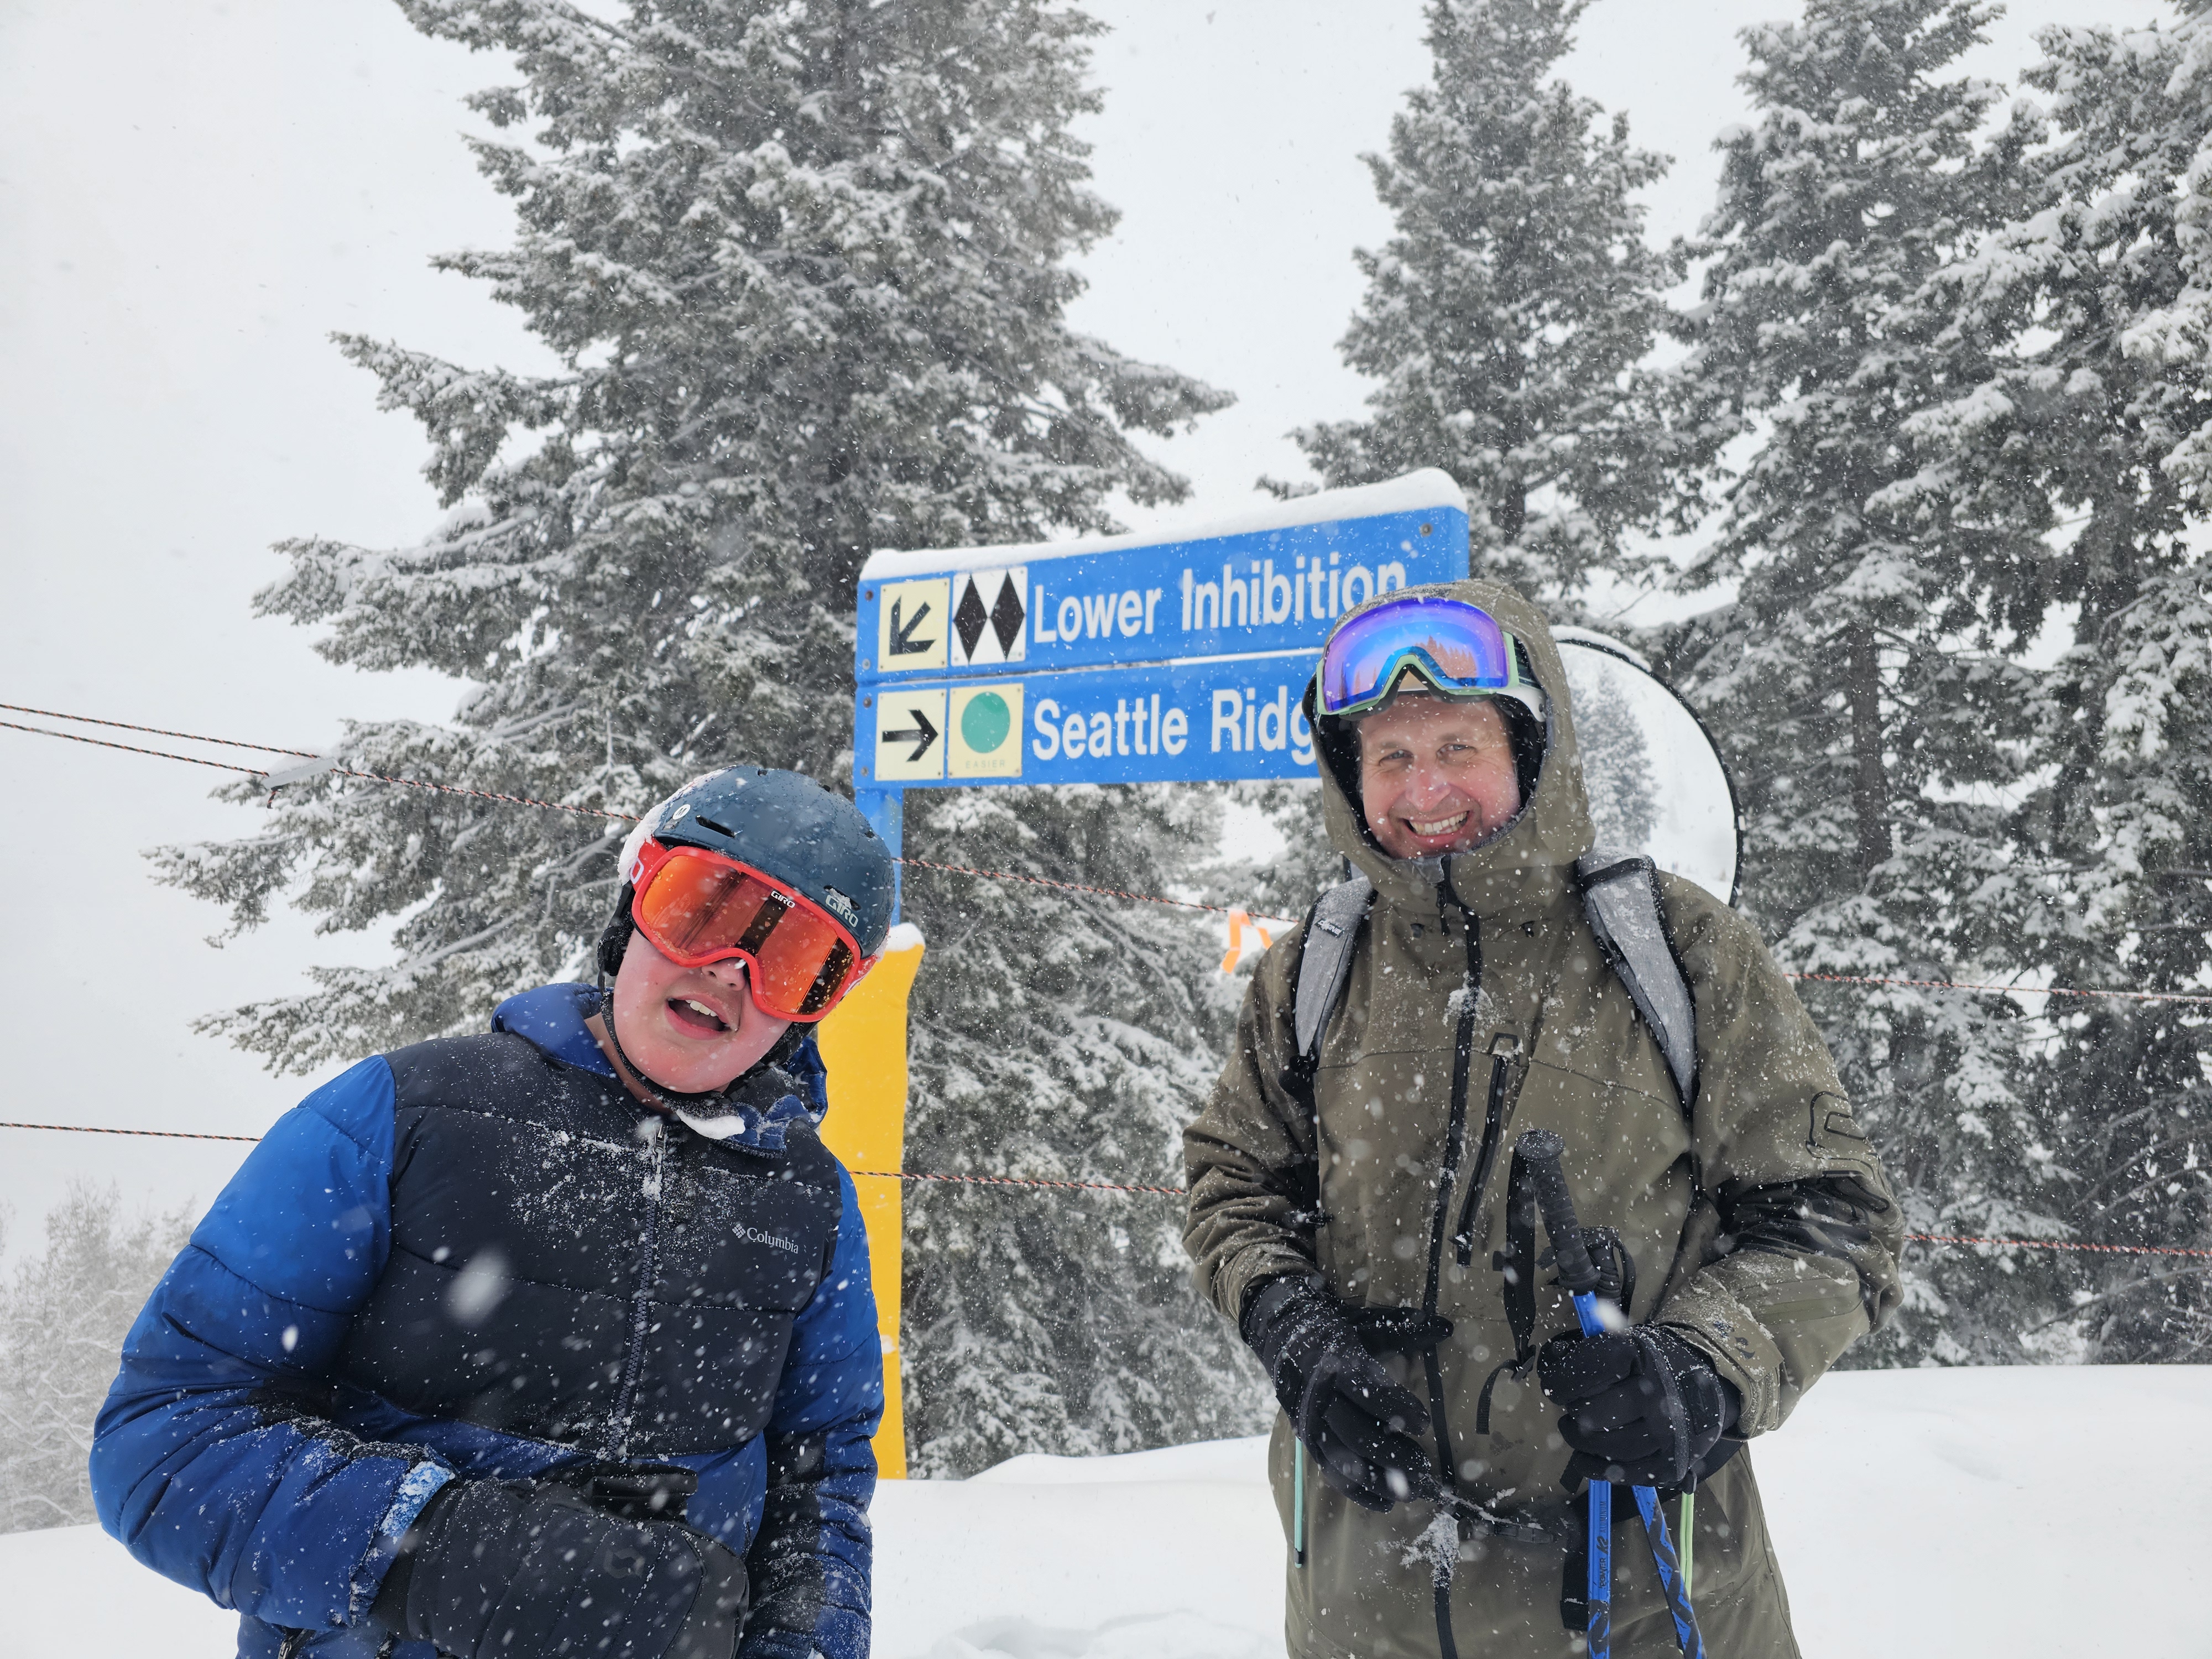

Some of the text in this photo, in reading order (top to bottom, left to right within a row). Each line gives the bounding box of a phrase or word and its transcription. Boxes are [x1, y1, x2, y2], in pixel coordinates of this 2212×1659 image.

[1034, 551, 1406, 643] Lower Inhibition
[1032, 693, 1188, 760] Seattle
[965, 759, 1005, 769] EASIER
[771, 890, 796, 909] GIRO
[825, 894, 859, 927] GIRO
[747, 1227, 799, 1254] Columbia
[1596, 1536, 1609, 1555] K2
